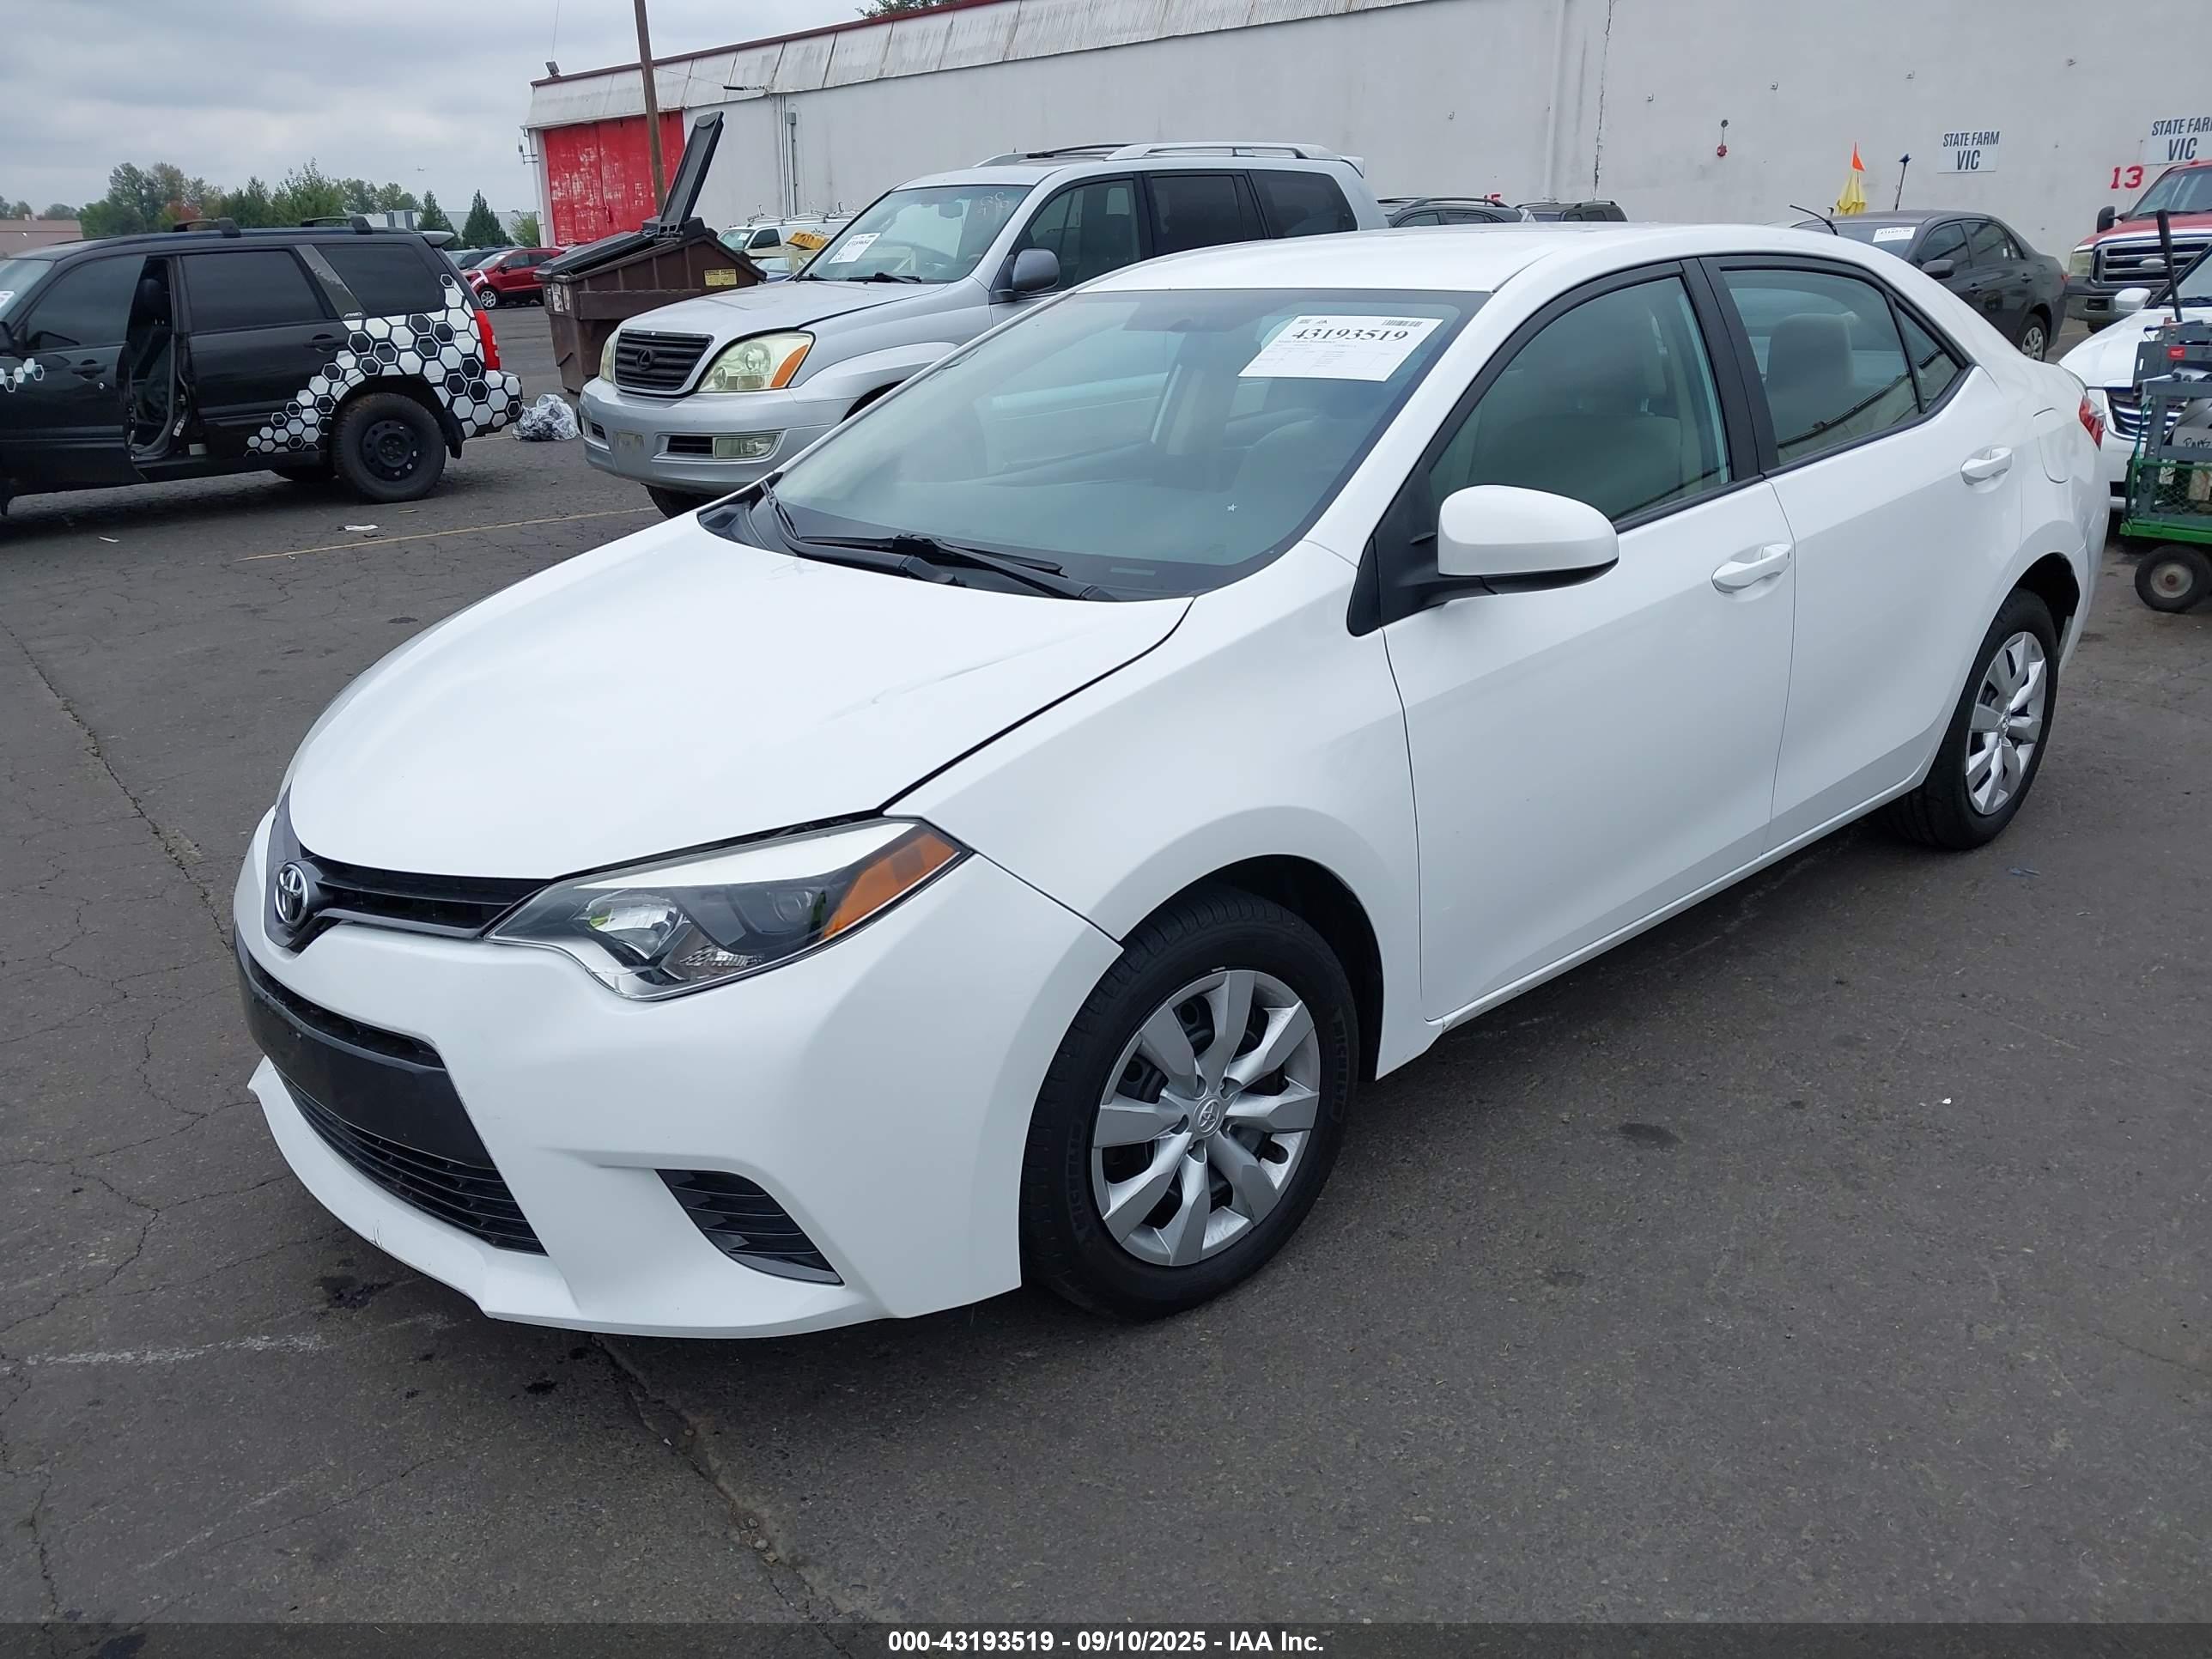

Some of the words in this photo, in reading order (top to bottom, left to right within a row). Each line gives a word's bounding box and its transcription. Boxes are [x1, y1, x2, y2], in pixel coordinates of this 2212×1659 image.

[2151, 118, 2185, 136] STATE
[2187, 116, 2212, 133] FAR
[1942, 132, 1969, 147] STATE
[1972, 131, 2000, 146] FARM
[2168, 137, 2198, 161] VIC
[1957, 149, 1981, 170] VIC
[2111, 165, 2144, 189] 13
[1291, 327, 1409, 342] 43193519
